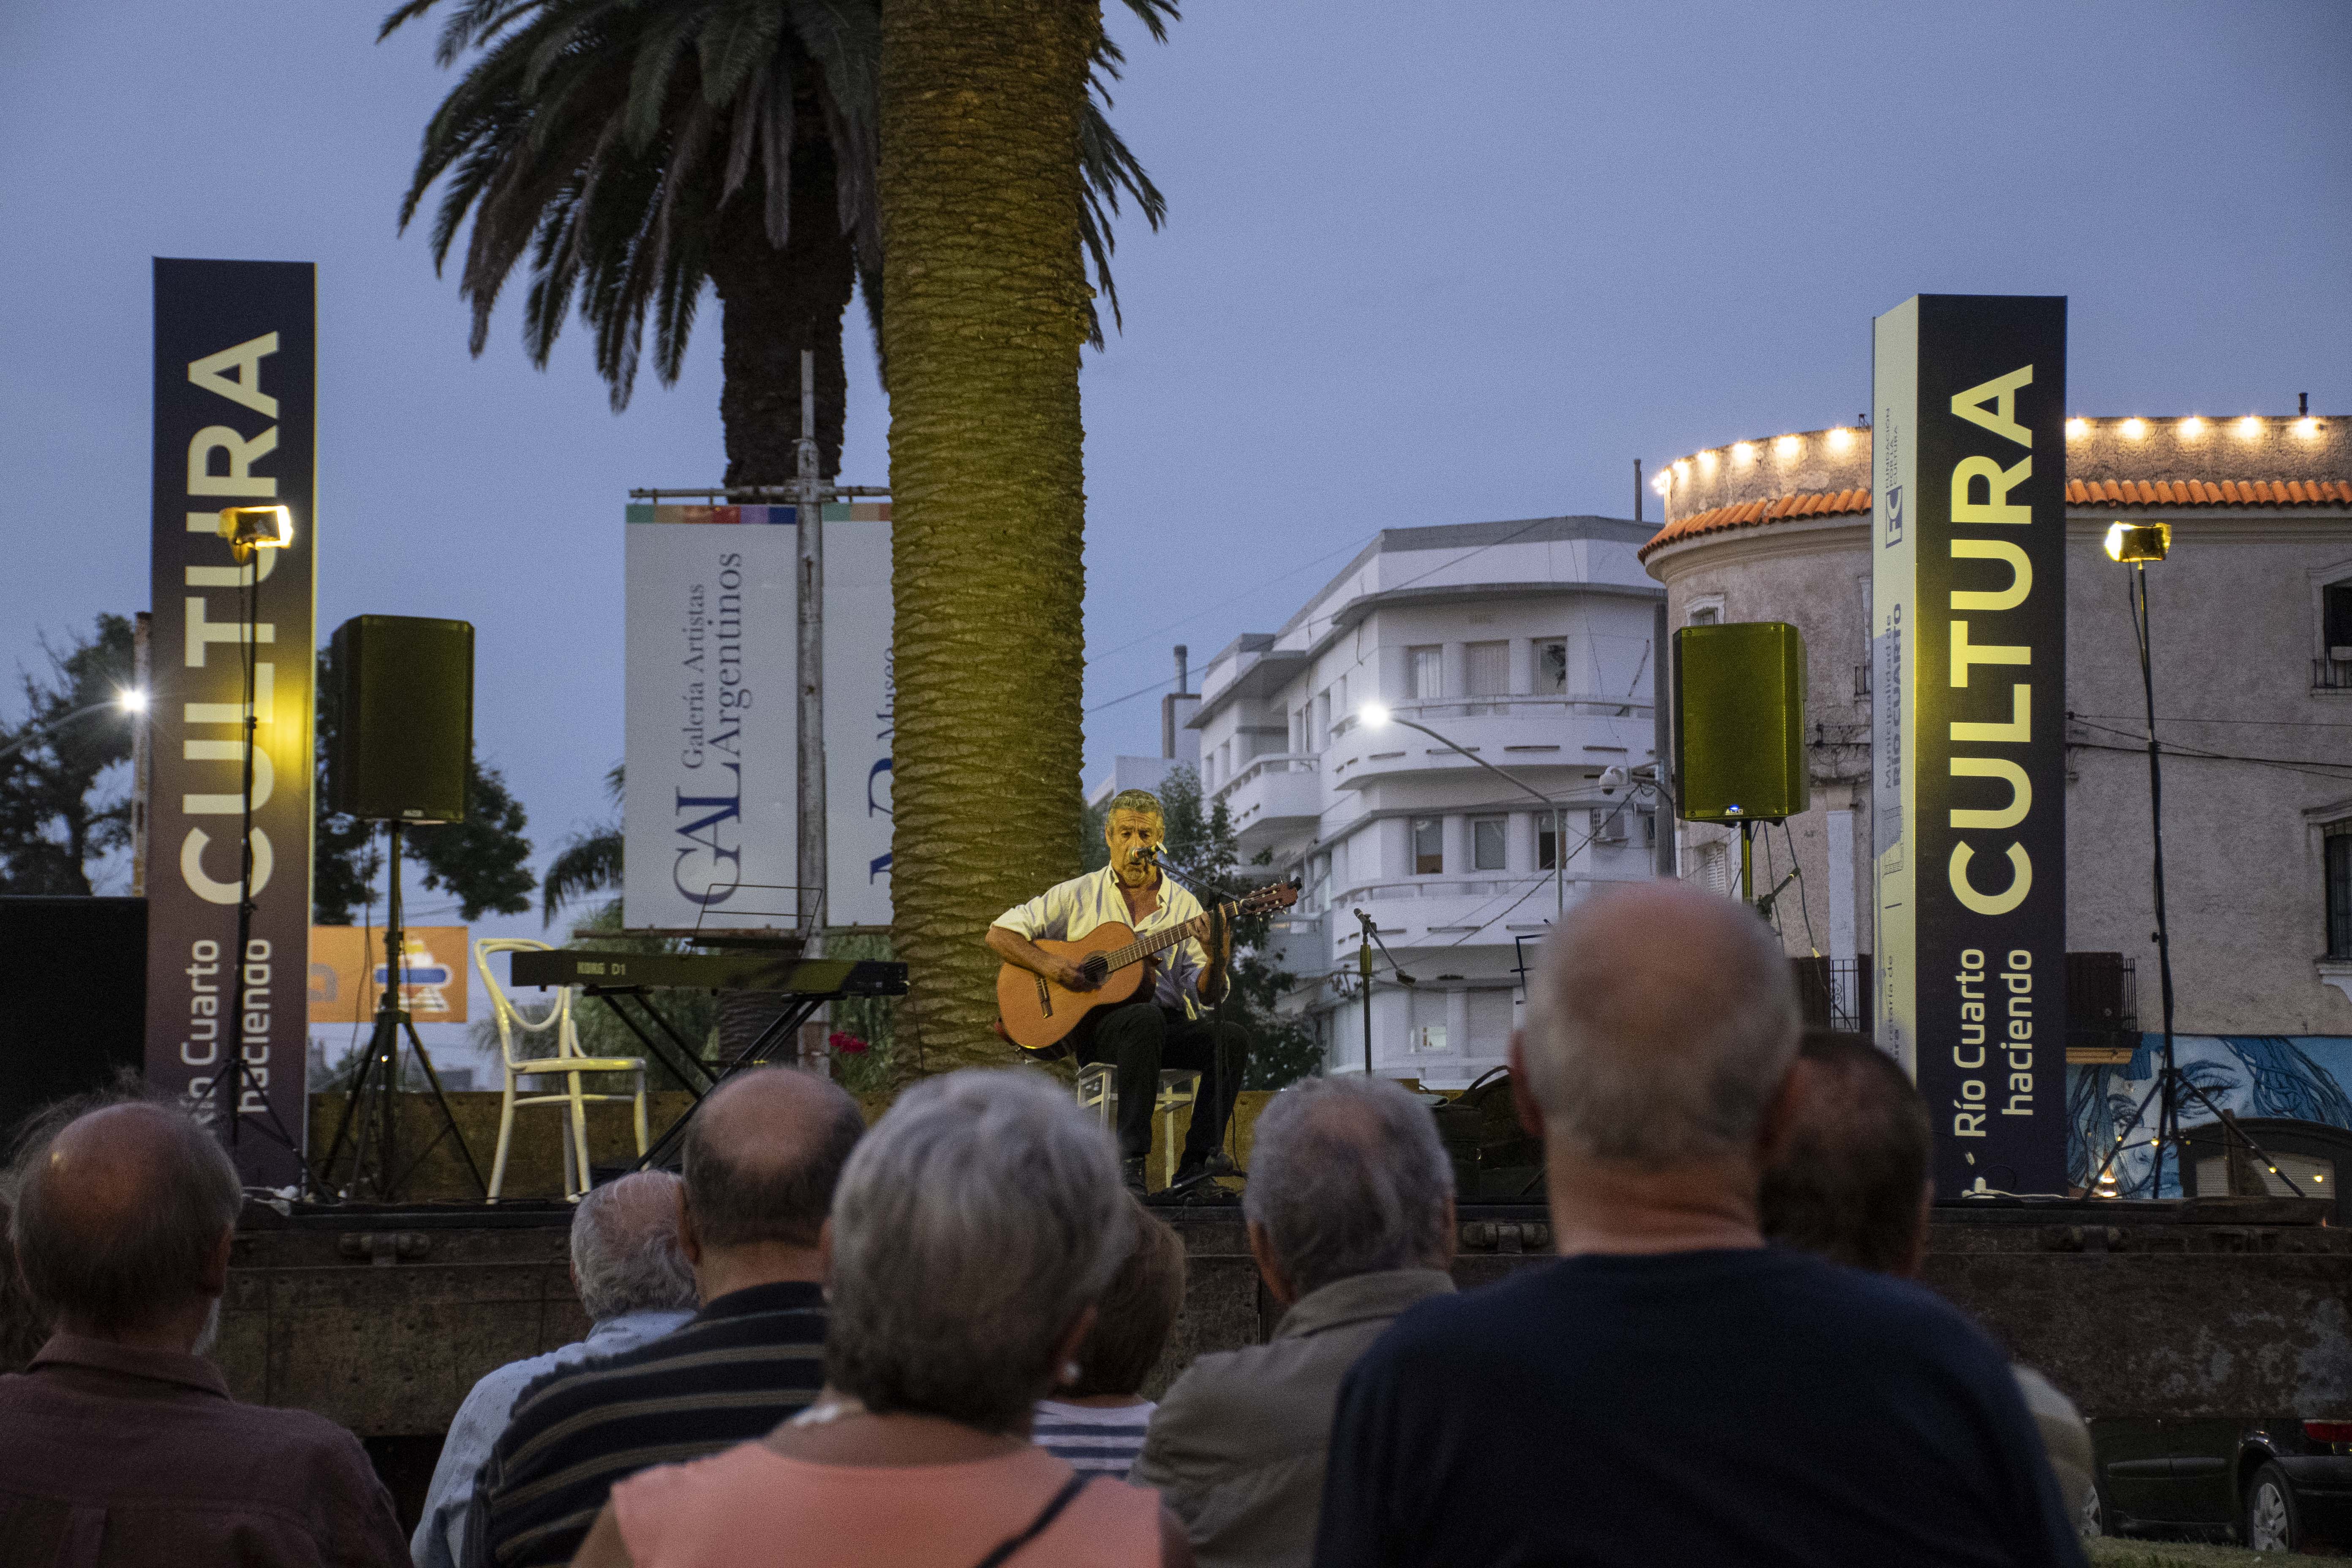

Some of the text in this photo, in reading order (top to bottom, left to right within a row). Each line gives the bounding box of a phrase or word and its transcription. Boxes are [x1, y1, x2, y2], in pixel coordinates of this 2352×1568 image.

[180, 331, 279, 904] CULTURA
[683, 583, 704, 769] Galería Artistas
[708, 553, 751, 757] Argentinos
[1886, 615, 1892, 639] de
[1893, 603, 1901, 726] CUARTO
[1949, 364, 2033, 915] CULTURA
[673, 762, 740, 904] GAL
[181, 939, 219, 1066] Cuarto
[238, 938, 271, 1113] haciendo
[1954, 948, 1986, 1137] Río Cuarto
[2001, 949, 2033, 1116] haciendo
